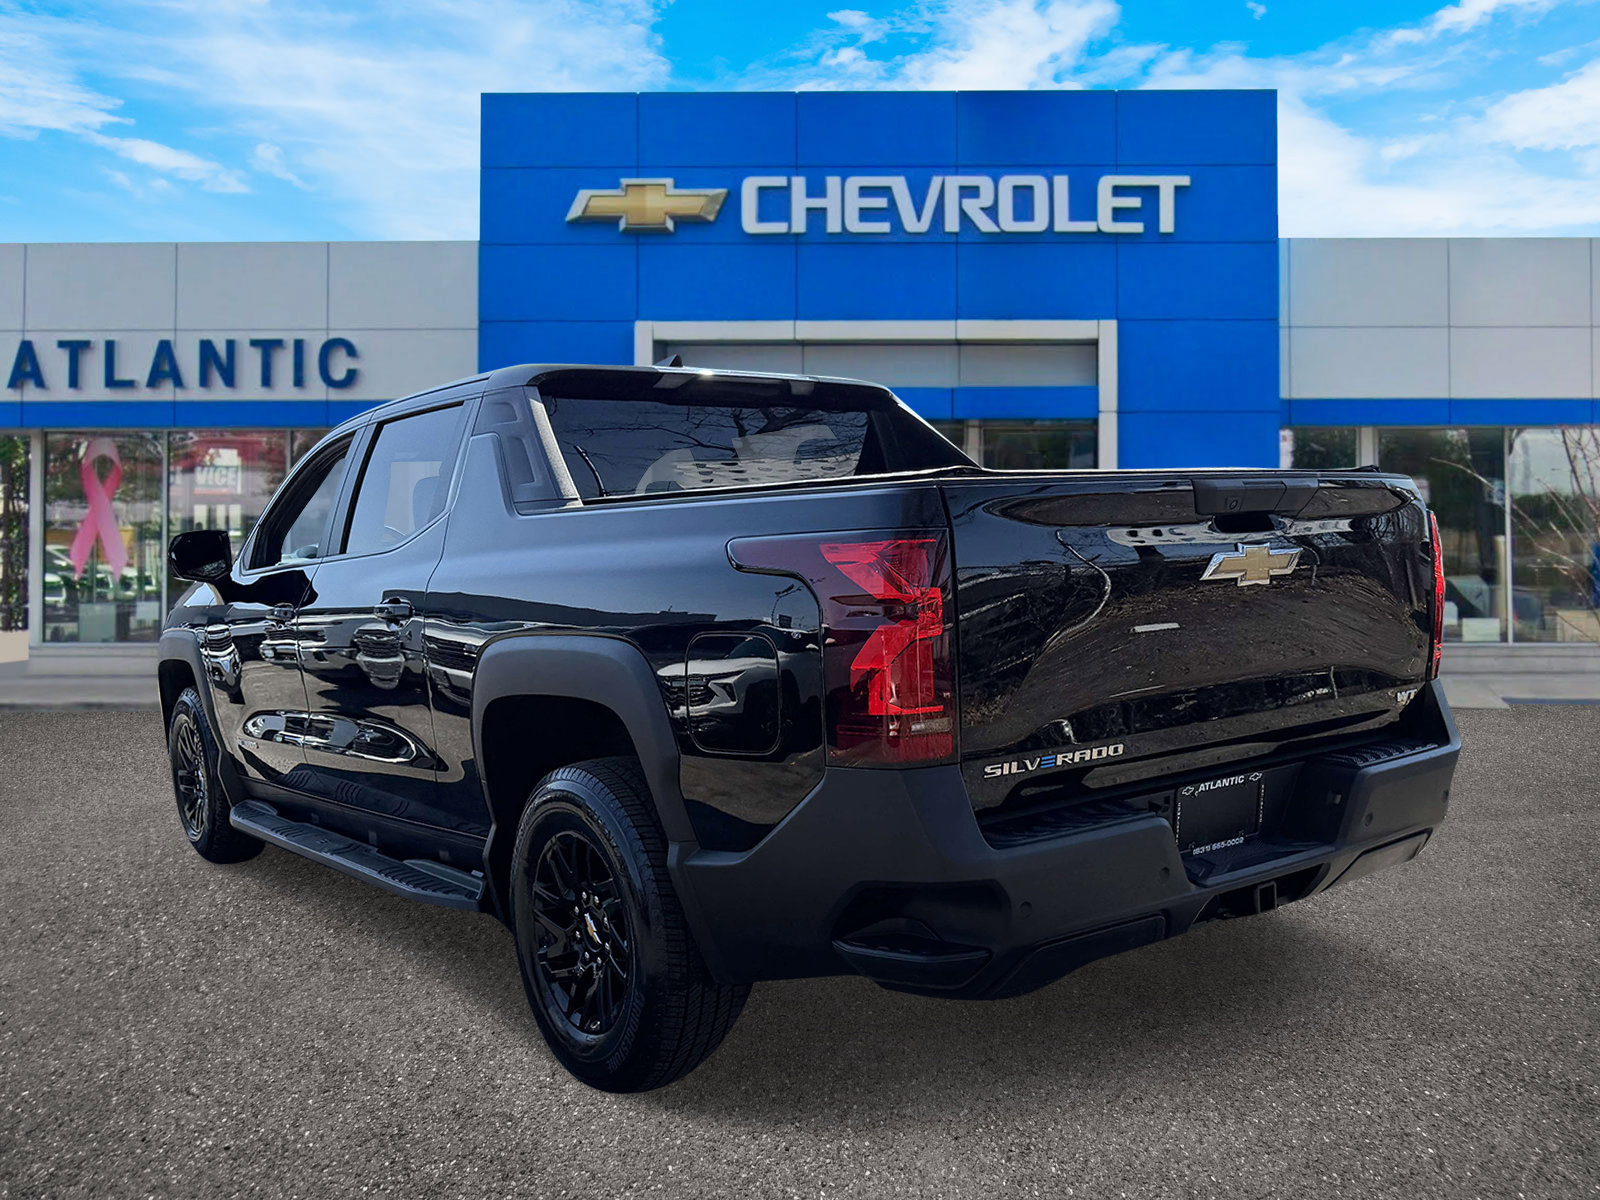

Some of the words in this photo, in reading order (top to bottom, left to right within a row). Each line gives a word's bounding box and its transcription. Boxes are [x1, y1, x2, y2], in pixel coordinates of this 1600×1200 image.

[741, 175, 1191, 233] CHEVROLET
[7, 337, 359, 389] ATLANTIC
[983, 743, 1124, 779] SILVERADO
[1198, 775, 1245, 793] ATLANTIC
